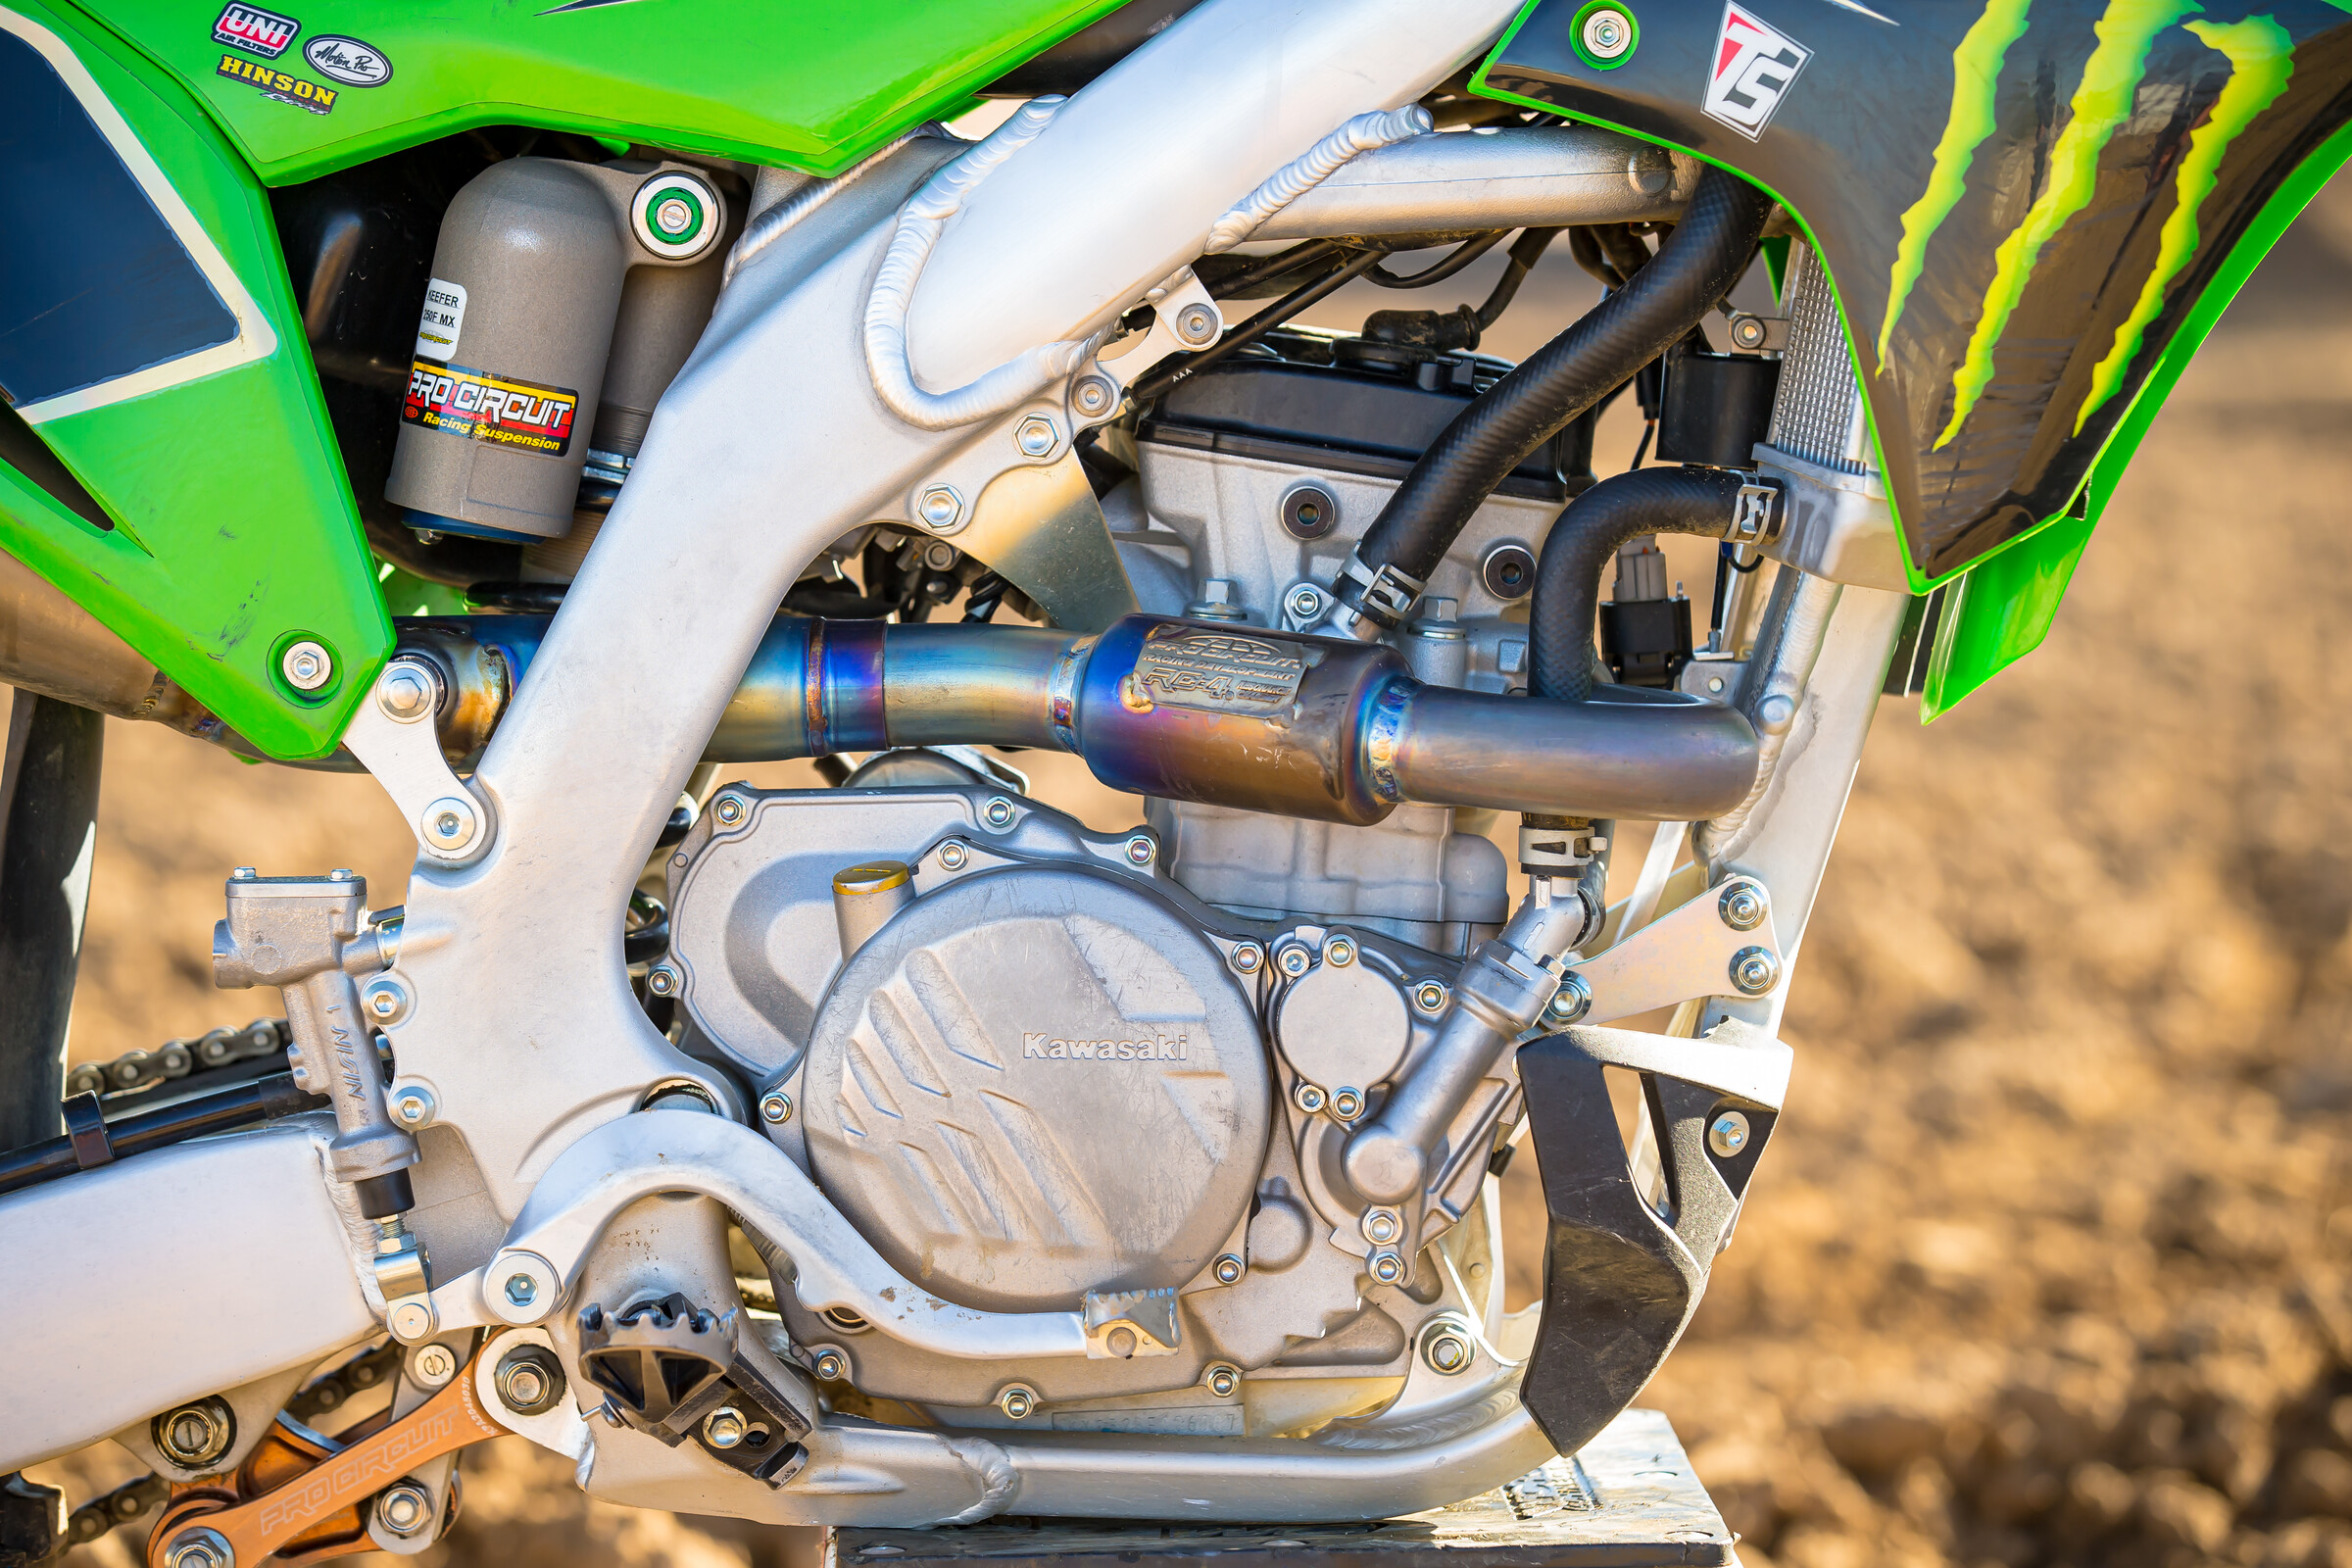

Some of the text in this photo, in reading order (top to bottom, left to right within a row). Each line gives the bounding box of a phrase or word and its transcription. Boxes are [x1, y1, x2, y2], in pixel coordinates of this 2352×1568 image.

[225, 9, 288, 45] UNI
[217, 32, 277, 56] AIR FILTERS
[314, 42, 380, 72] Motion Pro
[219, 55, 336, 106] HINSON
[440, 314, 456, 328] MX
[408, 369, 571, 428] PRO CIRCUIT
[422, 412, 561, 451] Racing Suspension
[1142, 653, 1196, 667] RACING
[1023, 1032, 1188, 1061] Kawasaki
[260, 1404, 460, 1537] PRO CIRCUIT
